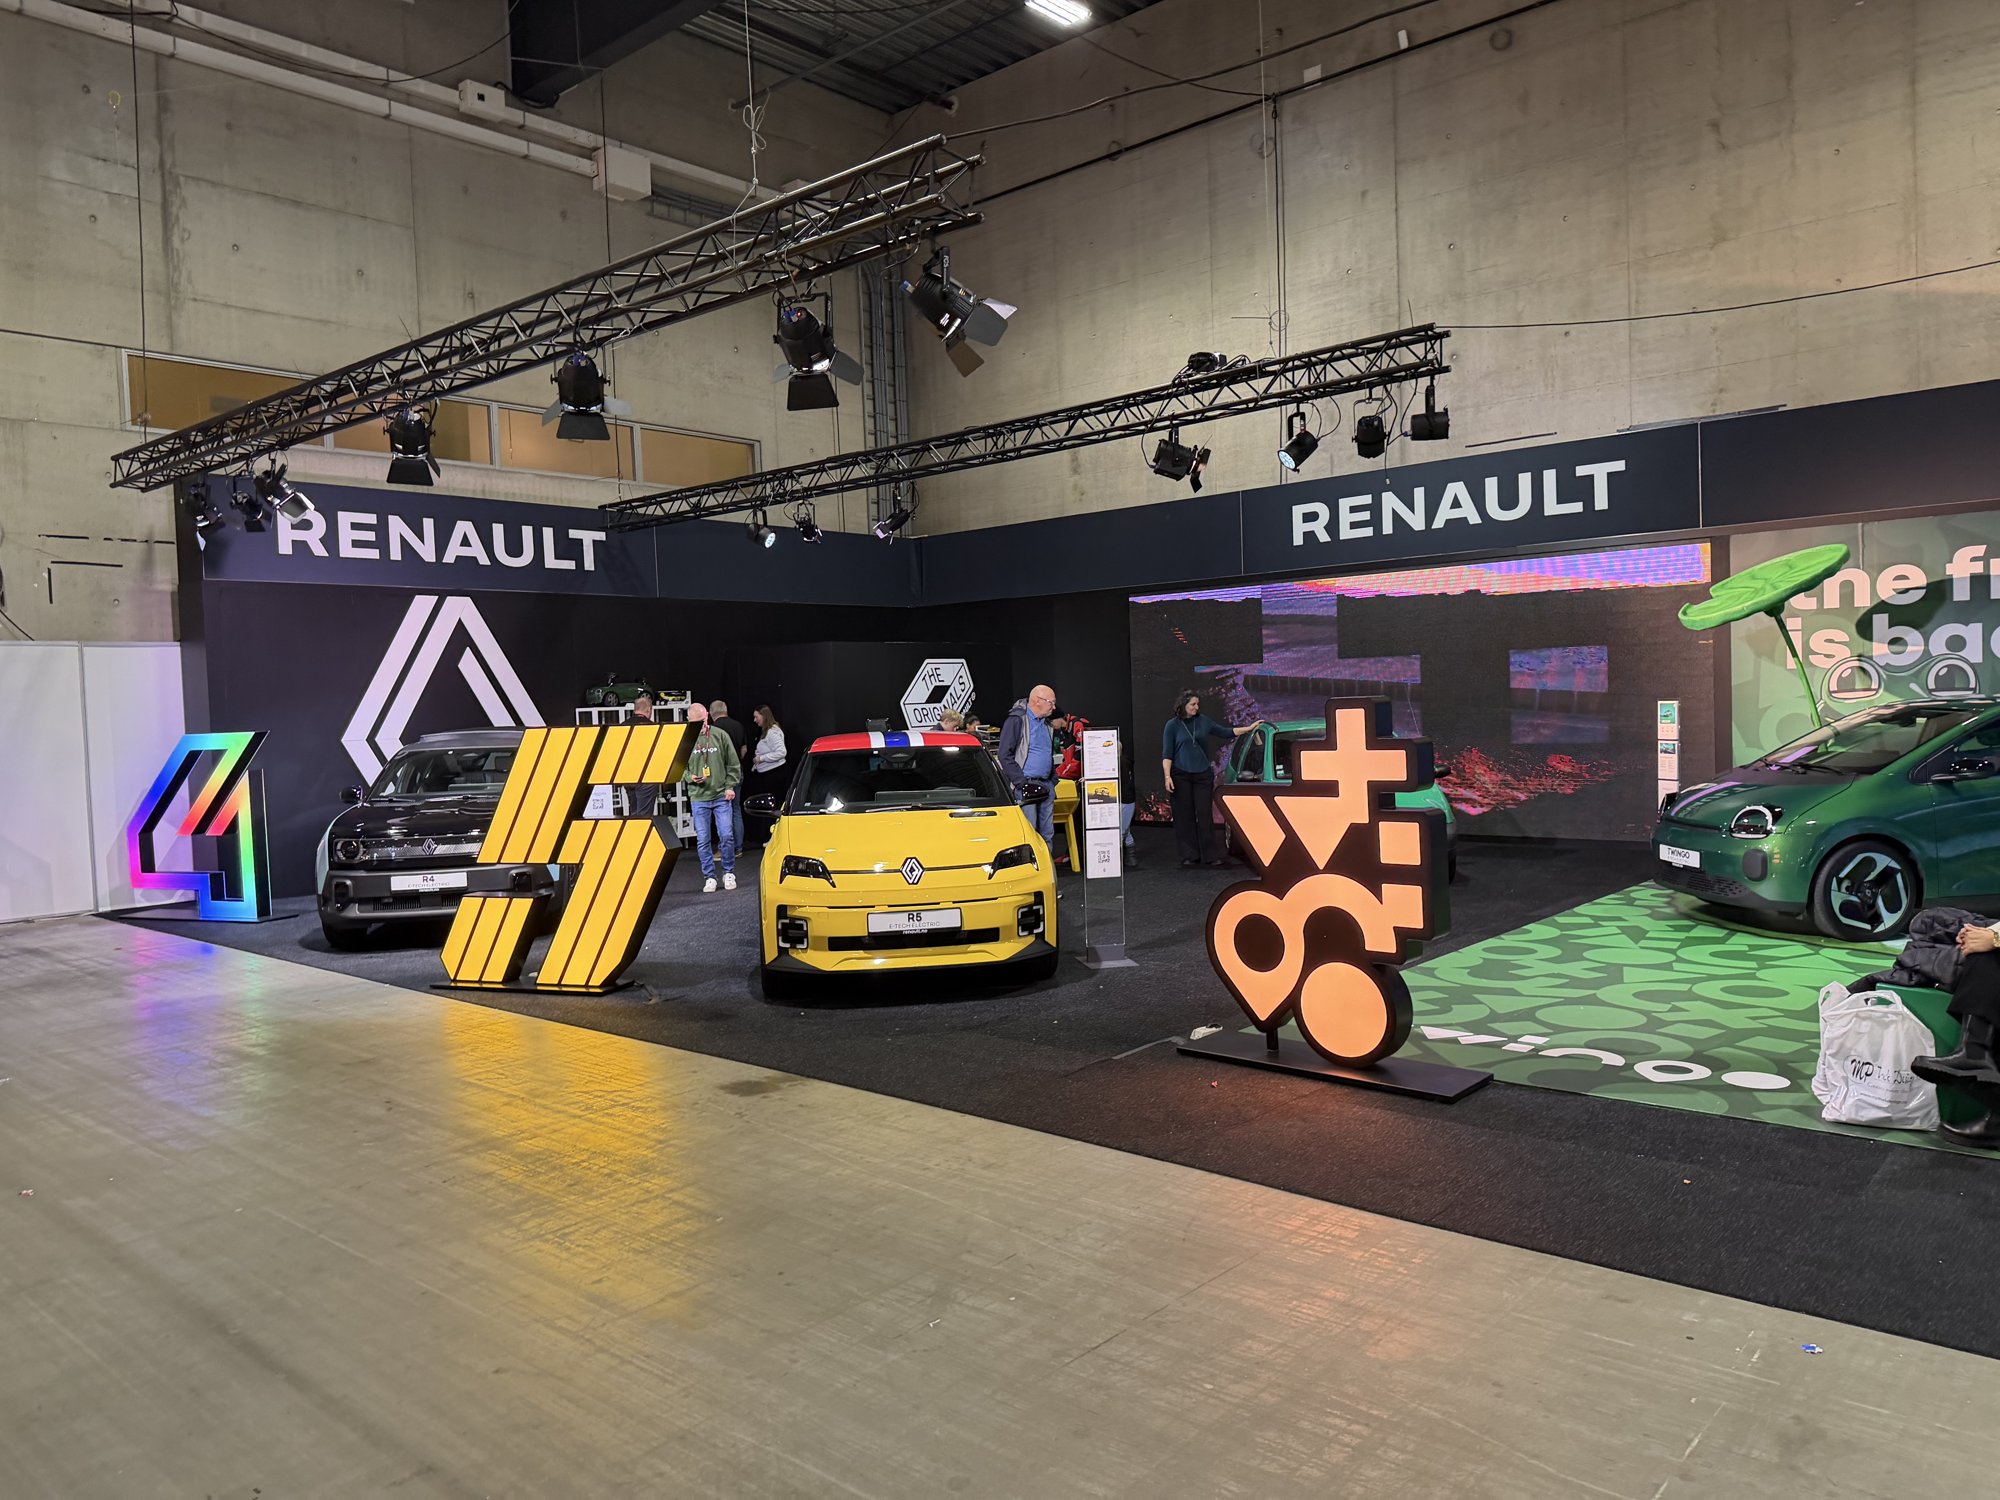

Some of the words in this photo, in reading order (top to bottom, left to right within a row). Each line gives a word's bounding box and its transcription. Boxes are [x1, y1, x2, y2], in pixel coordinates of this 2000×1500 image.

[1292, 459, 1626, 546] RENAULT
[276, 507, 606, 571] RENAULT
[1786, 617, 1851, 670] is
[1872, 613, 2000, 667] ba
[922, 667, 945, 691] THE
[1667, 847, 1690, 859] TWINGO
[422, 875, 435, 883] R4
[907, 912, 922, 922] R5
[1850, 1058, 1874, 1083] MP
